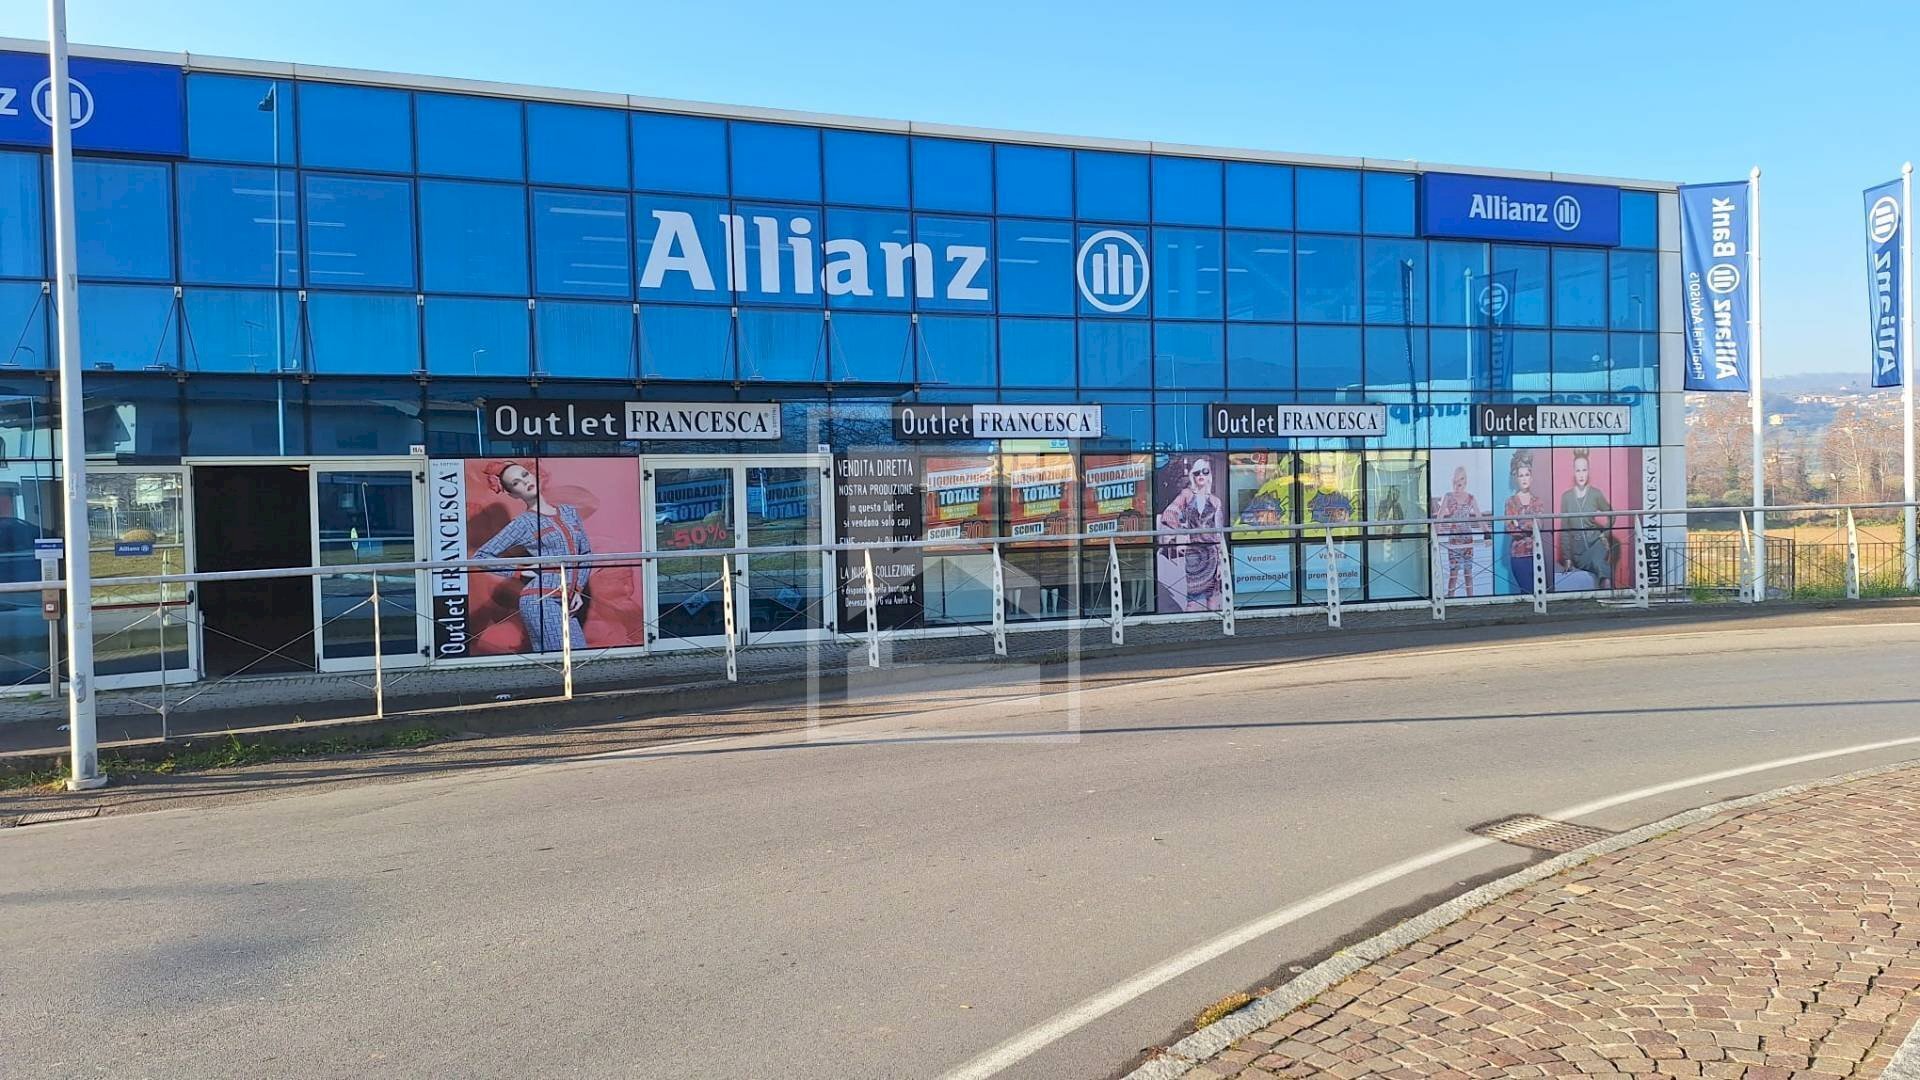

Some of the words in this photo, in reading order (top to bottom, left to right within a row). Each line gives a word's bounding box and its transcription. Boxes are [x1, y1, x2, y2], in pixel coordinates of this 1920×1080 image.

[1469, 194, 1548, 222] Allianz
[640, 209, 988, 301] Allianz
[495, 404, 618, 436] Outlet
[631, 410, 767, 433] FRANCESCA
[902, 406, 970, 435] Outlet
[980, 412, 1091, 432] FRANCESCA
[1217, 408, 1275, 433] Outlet
[1283, 411, 1378, 430] FRANCESCA
[1485, 408, 1535, 432] Outlet
[1541, 411, 1623, 429] FRANCESCA
[837, 459, 874, 477] VENDITA
[877, 458, 914, 477] DIRETTA
[1086, 466, 1145, 484] LIQUIDAZIONE
[838, 484, 868, 496] NOSTRA
[869, 483, 915, 496] PRODUZIONE
[939, 487, 980, 505] TOTALE
[1022, 485, 1062, 502] TOTALE
[1097, 482, 1134, 500] TOTALE
[858, 502, 881, 515] questo
[883, 499, 905, 512] Outlet
[851, 515, 879, 528] vendono
[881, 514, 895, 527] solo
[897, 515, 912, 529] capi
[1014, 523, 1042, 535] SCONTI
[1088, 521, 1115, 533] SCONTI
[439, 471, 461, 592] FRANCESCA
[666, 522, 727, 548] -50%
[929, 527, 959, 539] SCONTI
[1247, 554, 1277, 562] Vendita
[840, 566, 850, 579] LA
[851, 565, 867, 579] NUO
[875, 563, 916, 578] COLLEZIONE
[1308, 571, 1359, 580] promonale
[438, 597, 464, 654] Outlet
